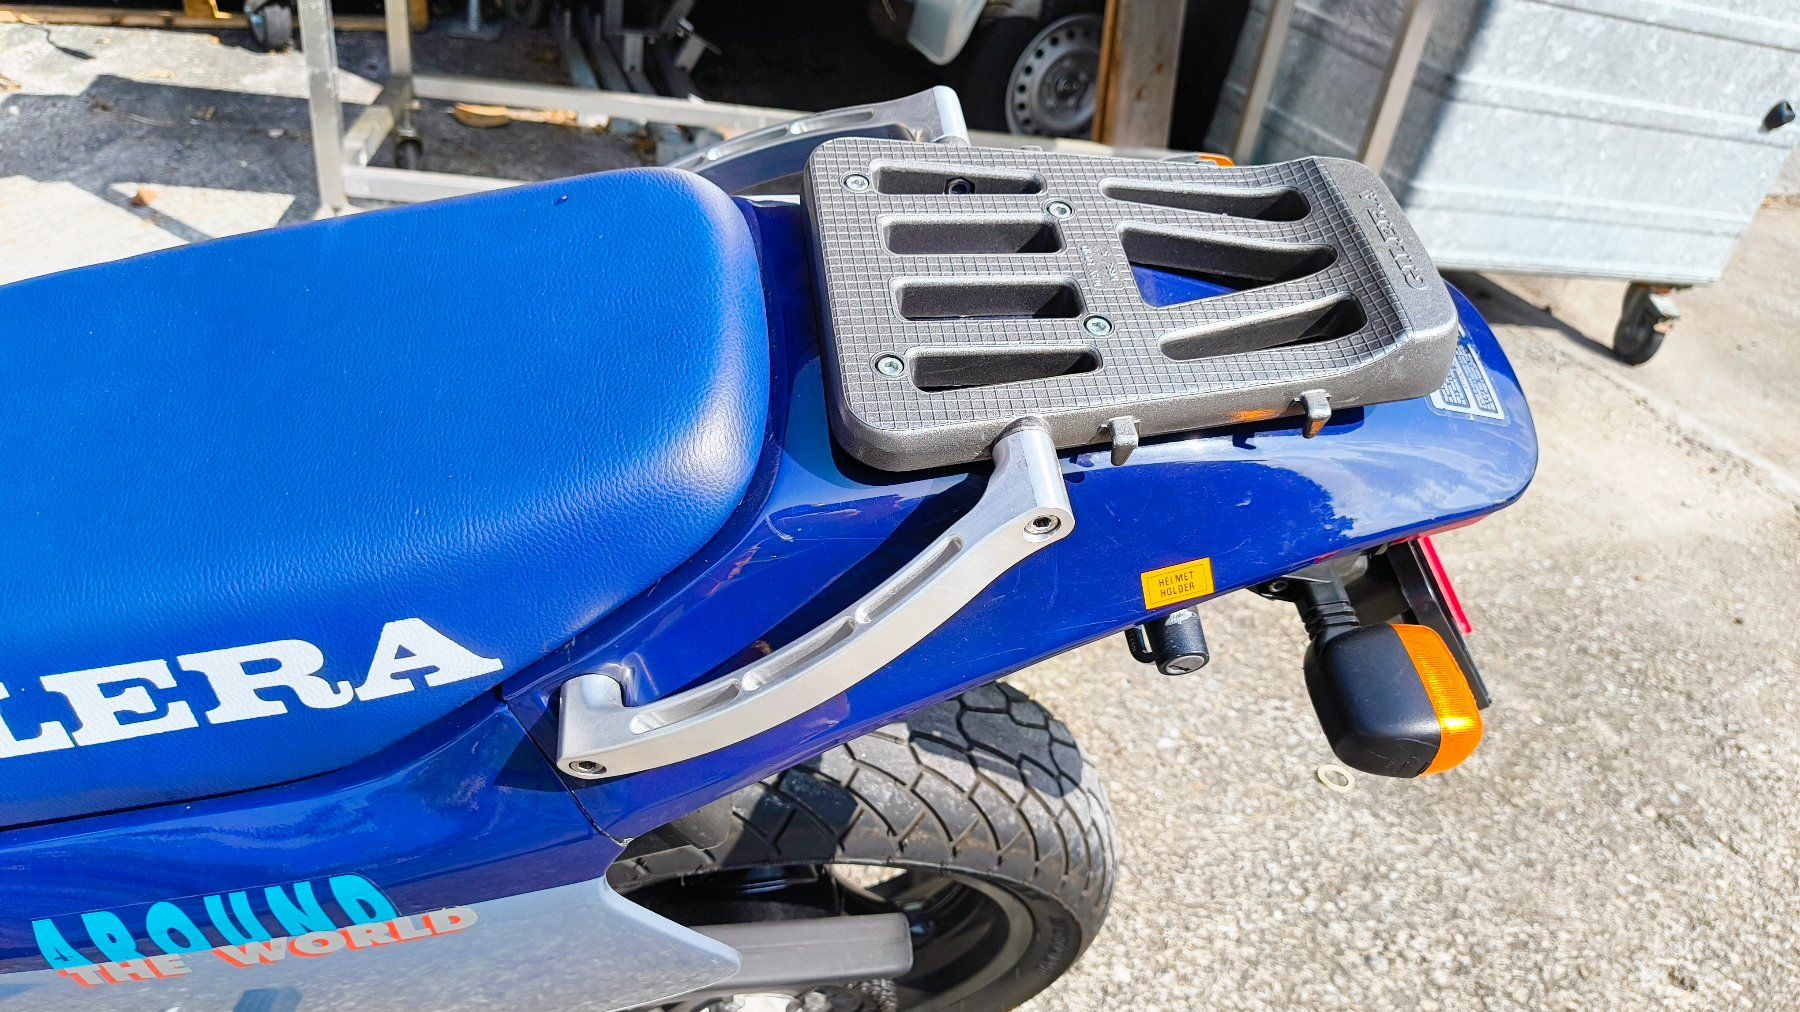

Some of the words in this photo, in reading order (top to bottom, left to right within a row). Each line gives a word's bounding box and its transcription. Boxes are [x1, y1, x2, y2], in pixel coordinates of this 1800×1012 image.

[1158, 570, 1195, 588] HELMET
[1160, 581, 1195, 598] HOLDER
[32, 875, 400, 970] AROUND
[56, 953, 193, 989] THE
[211, 906, 479, 969] WORLD
